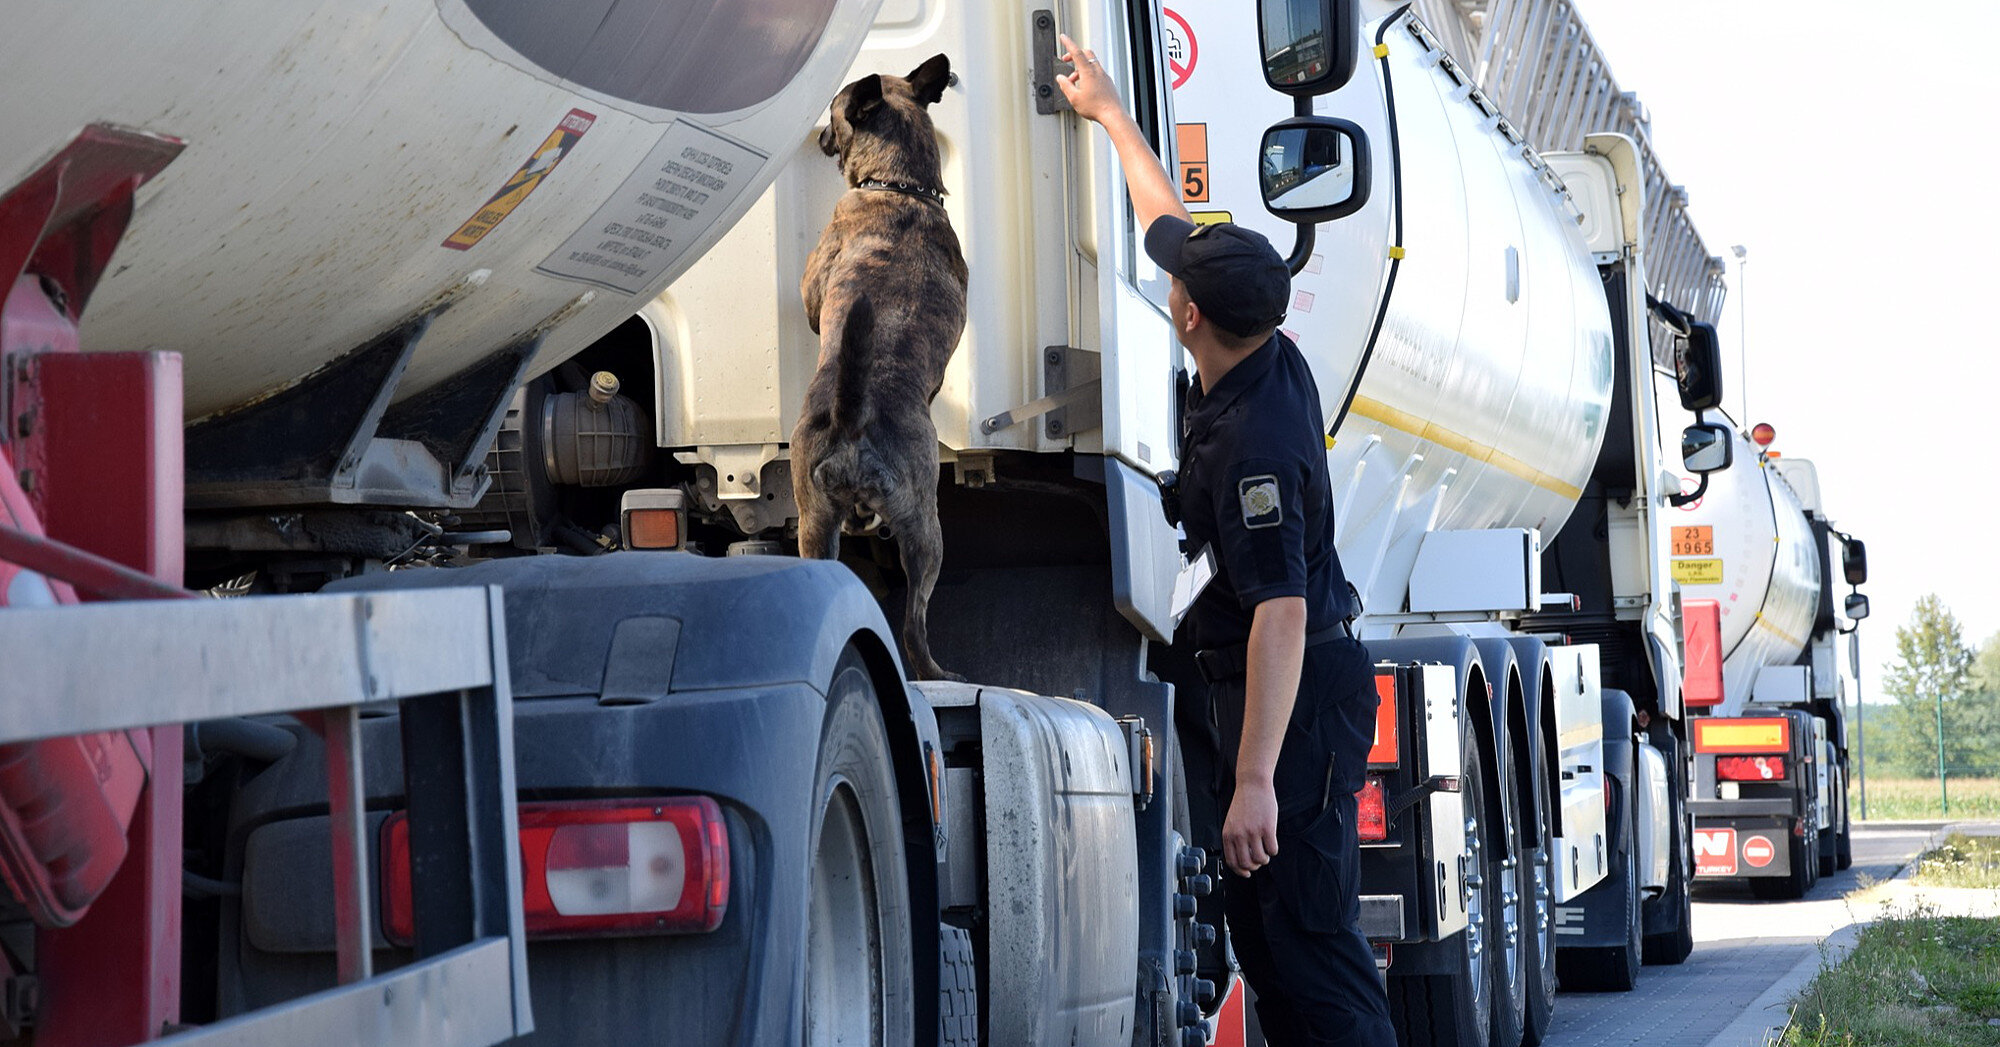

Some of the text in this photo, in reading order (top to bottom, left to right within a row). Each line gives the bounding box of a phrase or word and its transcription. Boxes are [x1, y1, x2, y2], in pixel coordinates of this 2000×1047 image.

[1685, 528, 1700, 539] 23
[1675, 542, 1712, 554] 1965
[1677, 561, 1713, 570] Danger
[1699, 865, 1732, 874] TURKEY
